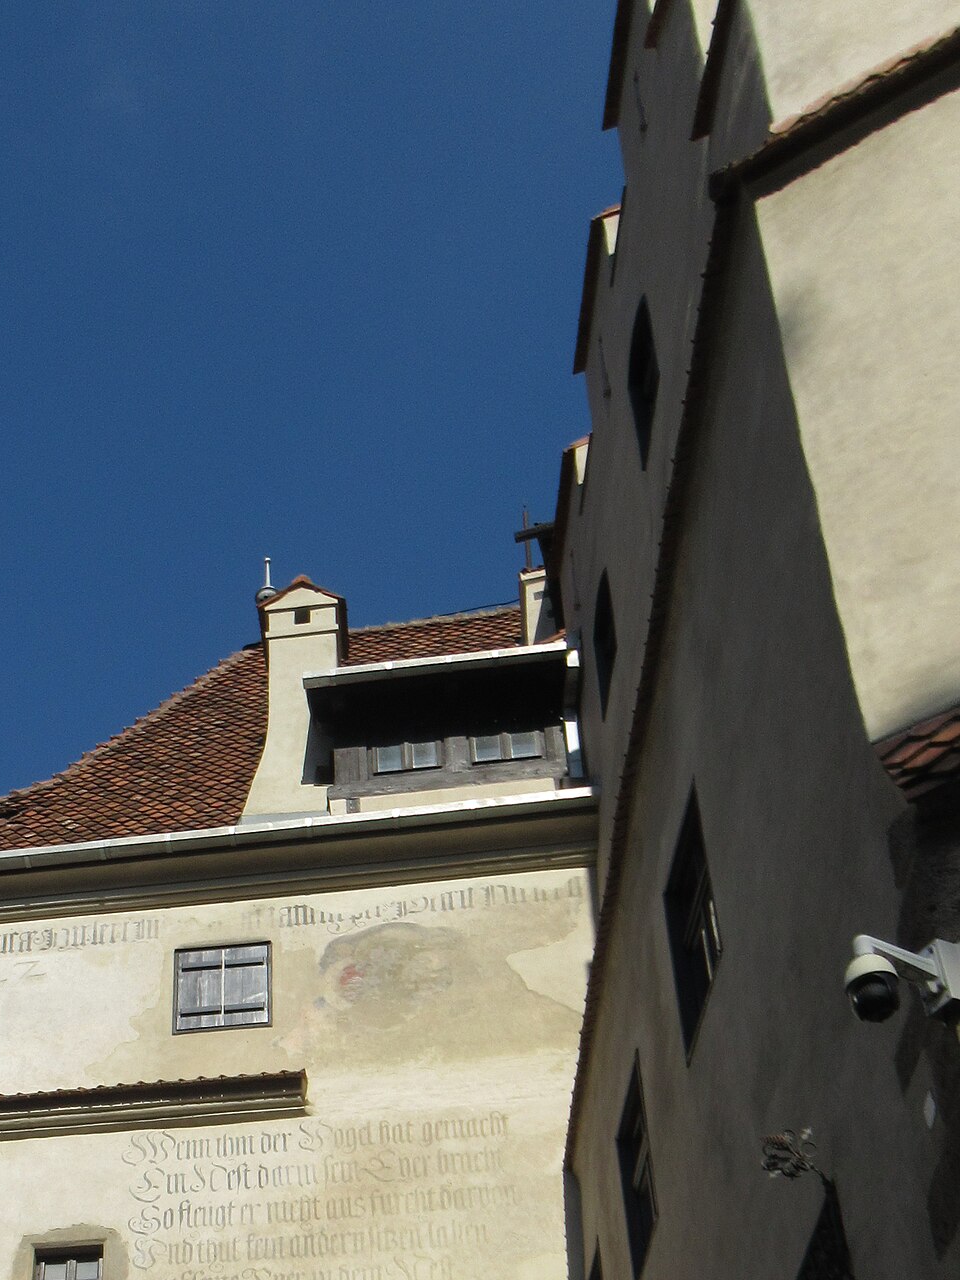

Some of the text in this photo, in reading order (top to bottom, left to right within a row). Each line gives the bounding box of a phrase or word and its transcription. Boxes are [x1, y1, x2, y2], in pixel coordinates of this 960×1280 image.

[261, 1131, 291, 1154] der
[378, 1119, 414, 1145] hat
[127, 1205, 174, 1236] So
